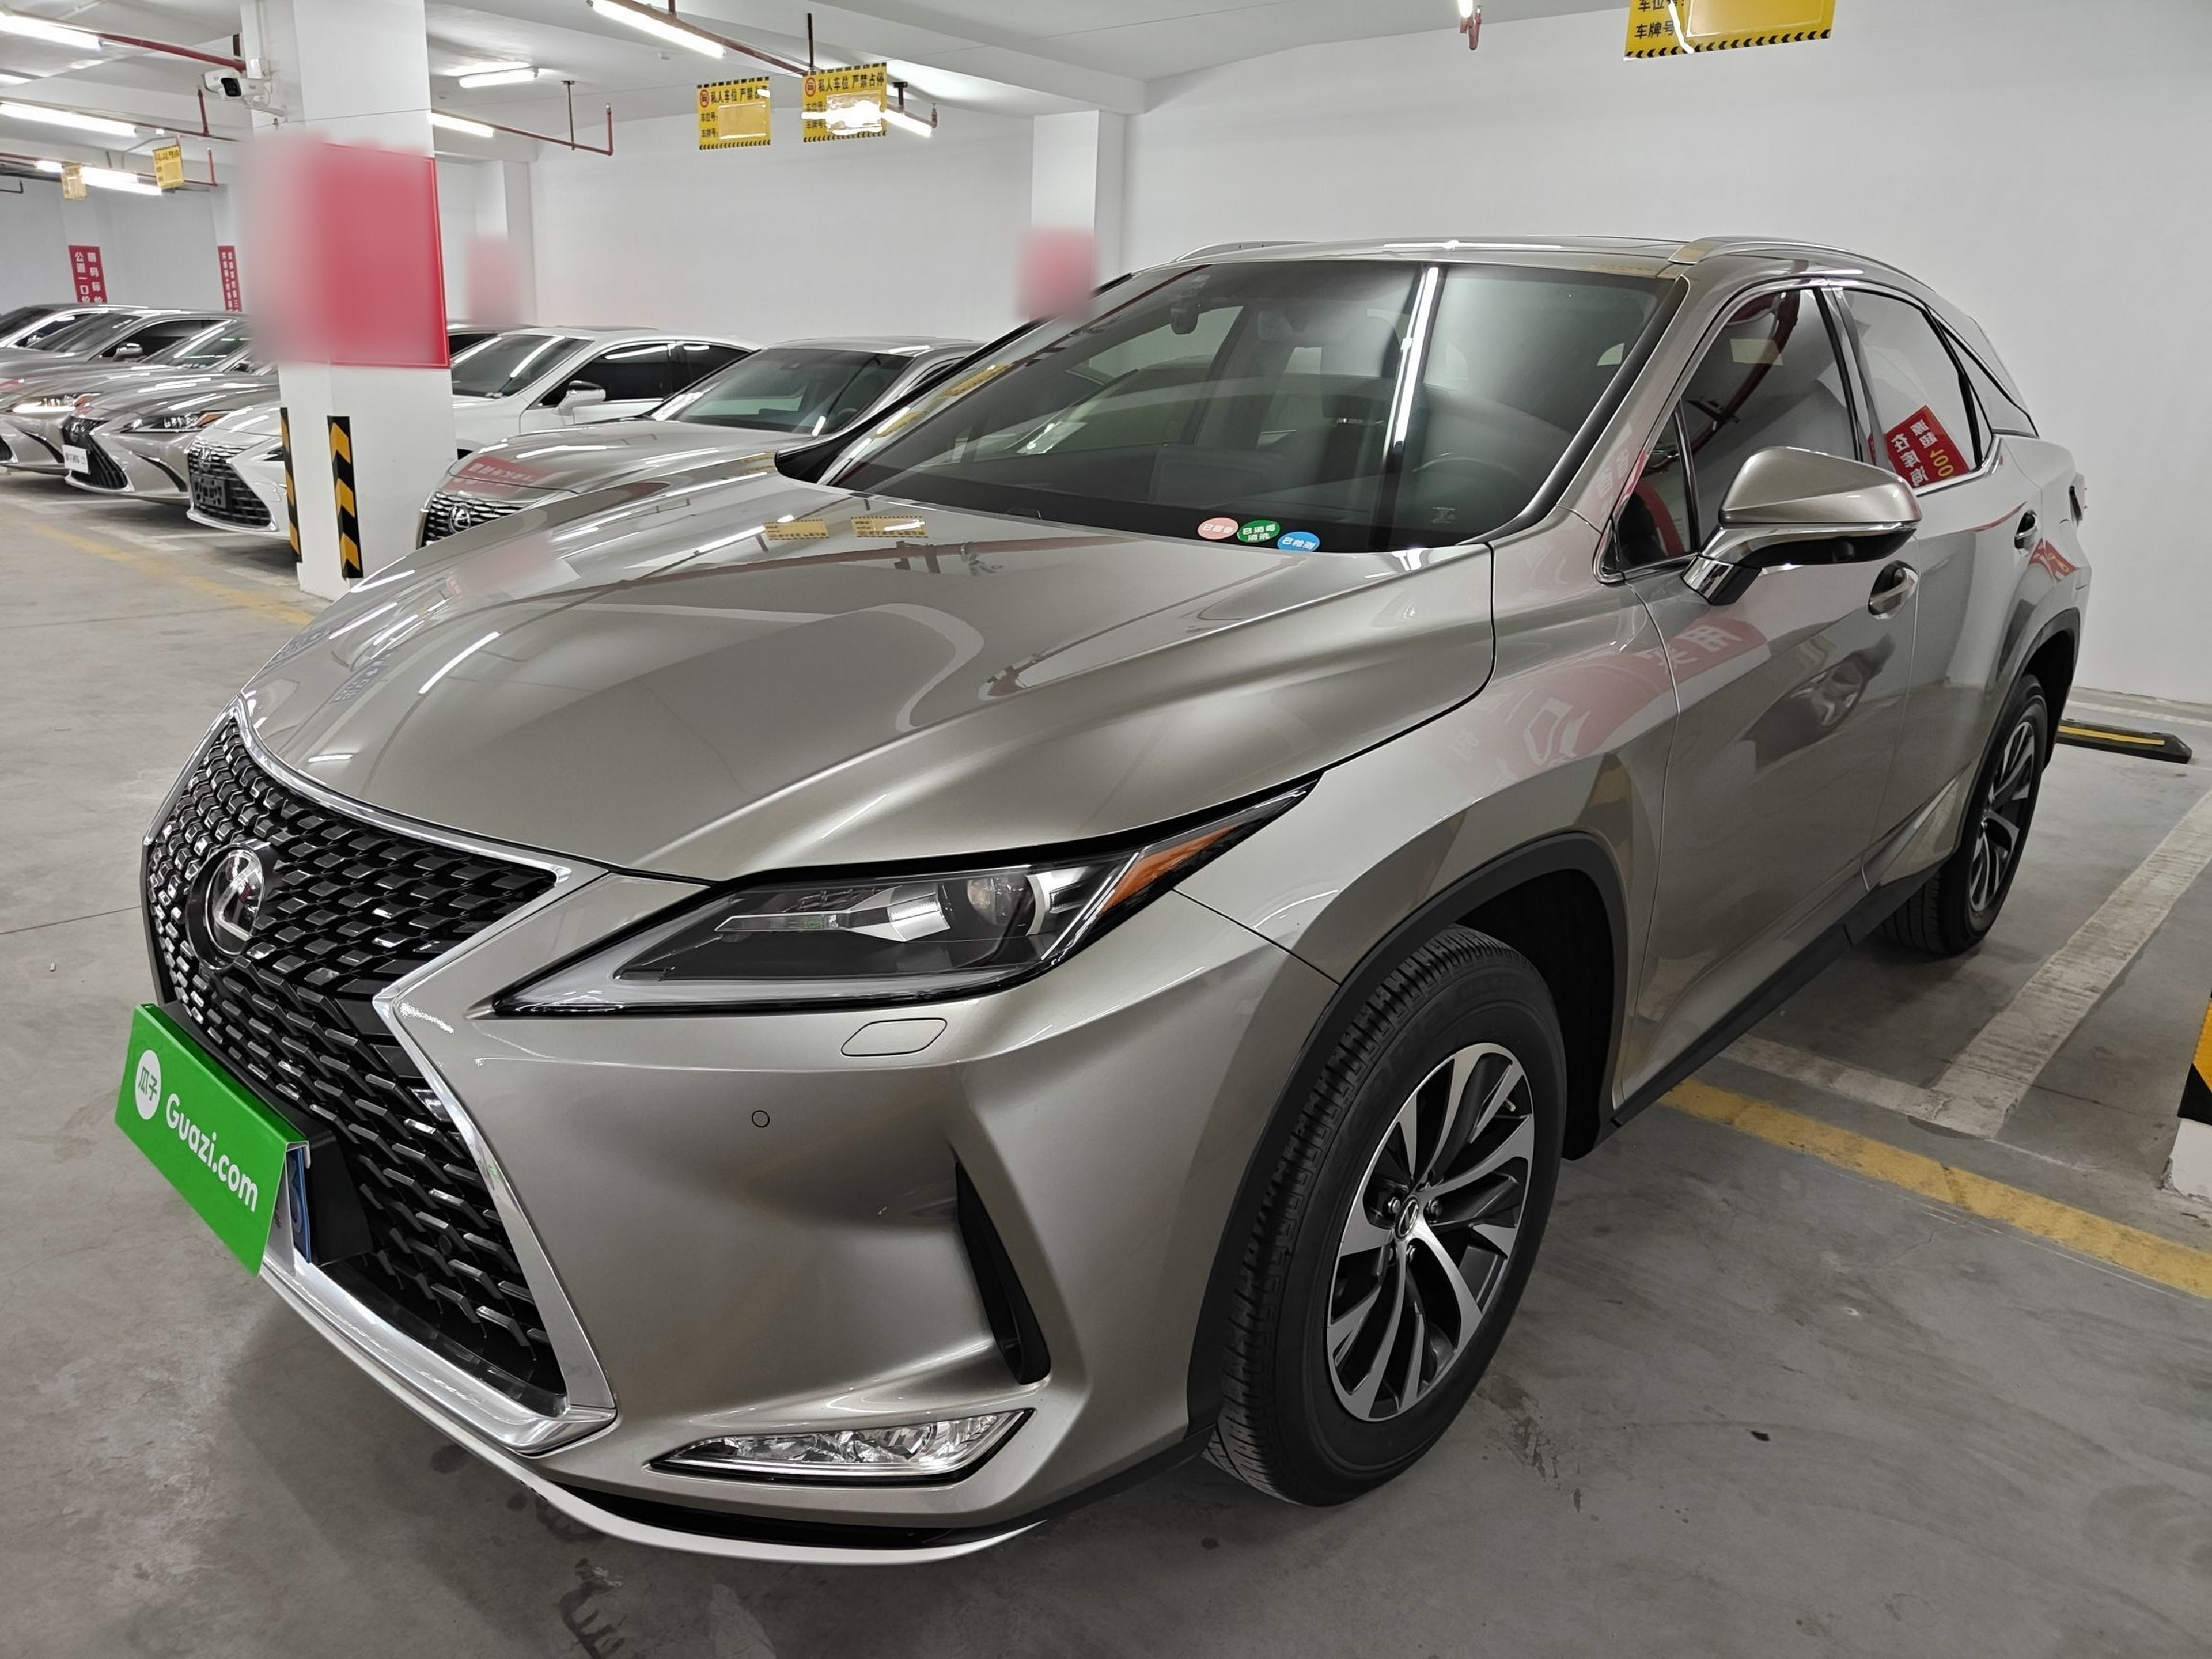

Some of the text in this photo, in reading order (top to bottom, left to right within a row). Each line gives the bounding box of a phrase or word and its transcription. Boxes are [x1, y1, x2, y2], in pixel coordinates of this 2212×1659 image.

[818, 71, 885, 92] 私人车位 严禁占停
[710, 88, 738, 104] 私人车位
[138, 1066, 158, 1101] 瓜子
[166, 1093, 258, 1213] Guazi.com
